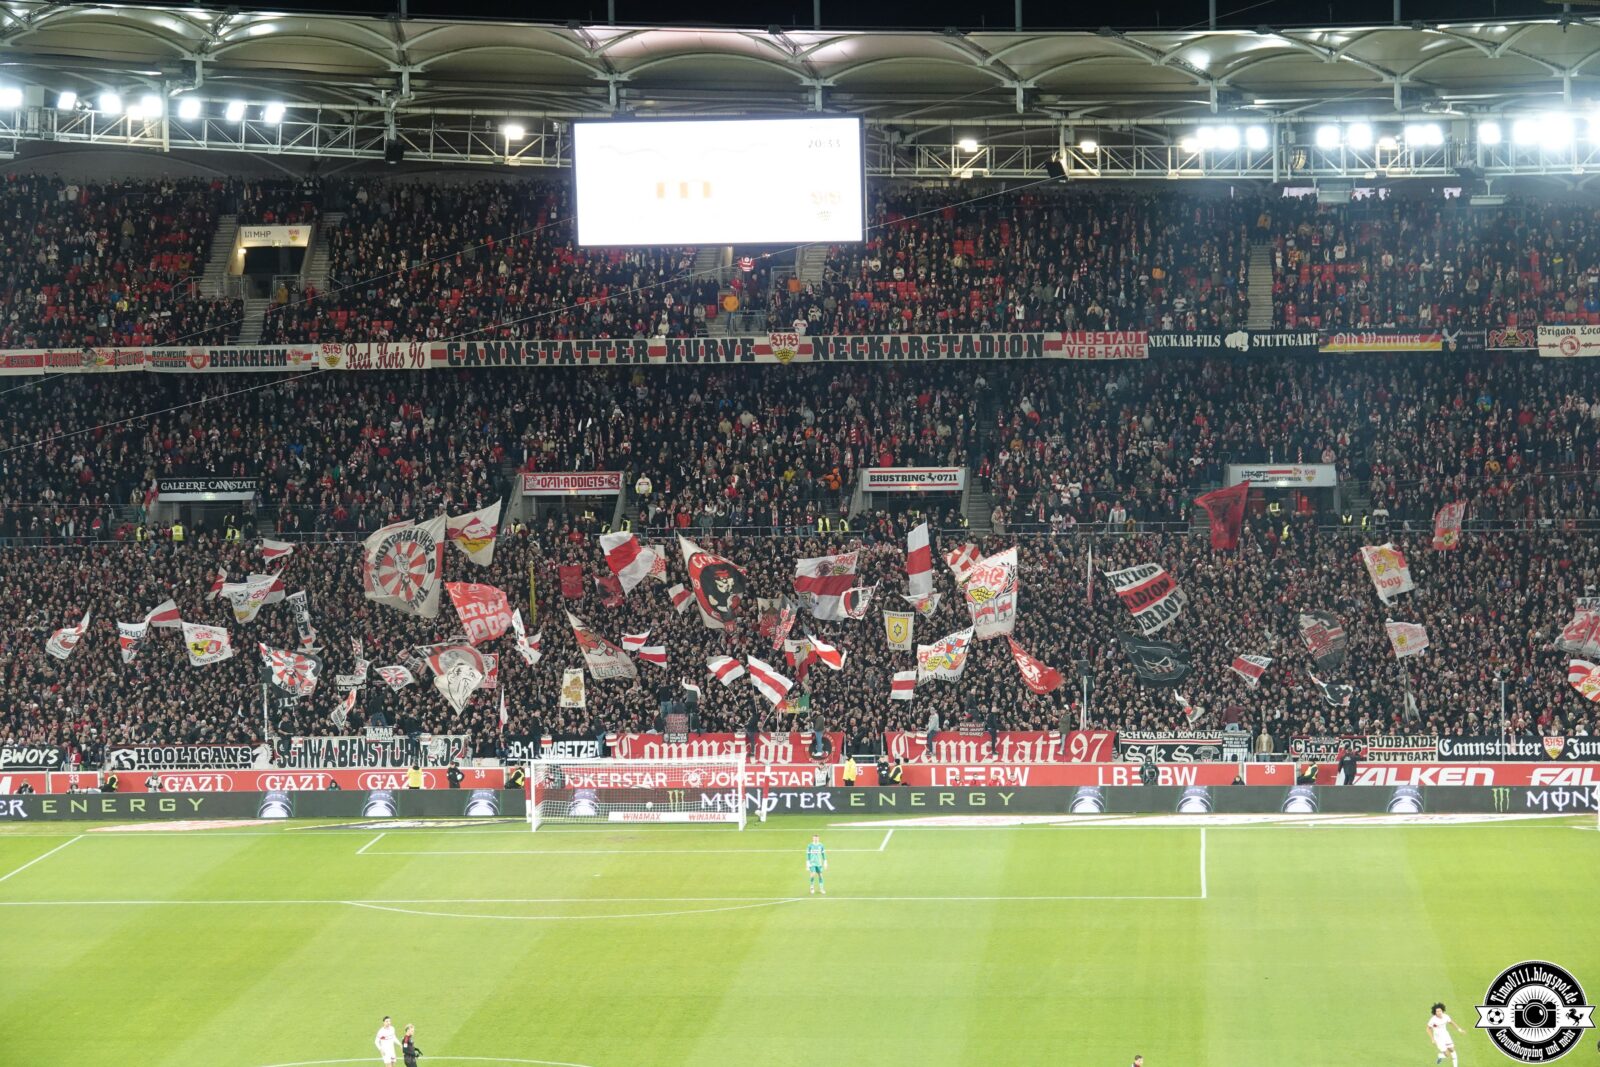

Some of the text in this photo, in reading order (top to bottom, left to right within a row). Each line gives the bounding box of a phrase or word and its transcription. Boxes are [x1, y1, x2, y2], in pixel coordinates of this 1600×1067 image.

[1065, 331, 1147, 344] ALBSTADT
[1148, 333, 1318, 347] NECKAR-FILS STUTTGART
[1333, 331, 1421, 346] Old Warriors
[448, 337, 755, 365] CANNSTATTER KURVE
[812, 334, 1044, 360] NECKARSTADION
[1067, 346, 1144, 358] VFB-FANS
[210, 349, 287, 367] BERKHEIM
[346, 342, 425, 369] Red Hots 96
[541, 476, 605, 488] 0711 ADDICTS
[870, 474, 926, 482] BRUSTRING
[1119, 730, 1223, 739] SCHWABEN KOMPANIE
[1069, 732, 1109, 763] 97
[136, 747, 251, 764] HOOLIGANS
[1368, 751, 1437, 761] STUTTGART
[474, 769, 485, 778] 34
[1264, 765, 1276, 774] 36
[69, 774, 80, 783] 33
[564, 772, 668, 787] JOKERSTAR
[850, 792, 1015, 806] ENERGY
[42, 798, 204, 814] ENERGY
[623, 813, 662, 821] WINAMAX
[688, 812, 727, 821] WINAMAX
